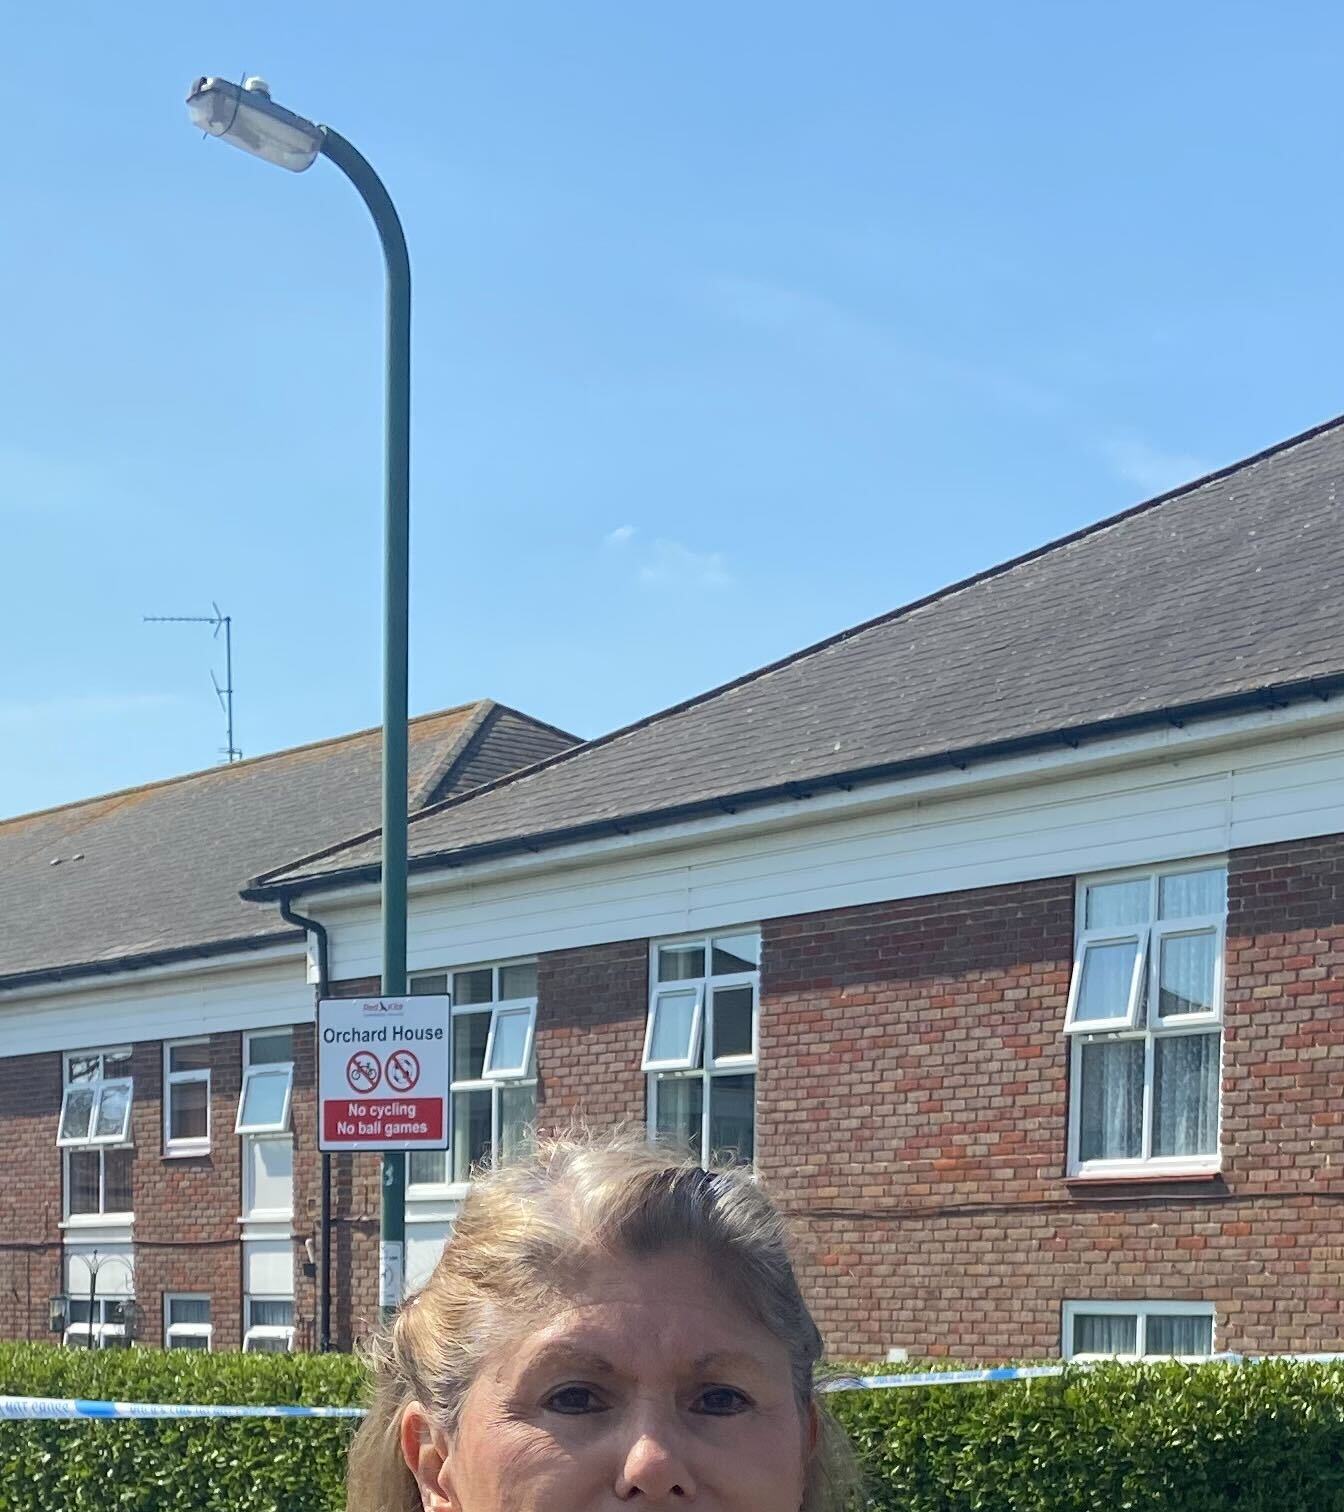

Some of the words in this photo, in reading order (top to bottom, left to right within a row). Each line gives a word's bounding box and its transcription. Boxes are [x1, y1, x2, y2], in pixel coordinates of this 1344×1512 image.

[323, 1026, 387, 1044] Orchard
[392, 1025, 444, 1041] House
[348, 1103, 366, 1117] No
[369, 1101, 417, 1119] cycling
[337, 1122, 355, 1135] No
[358, 1121, 381, 1135] ball
[384, 1121, 428, 1137] games
